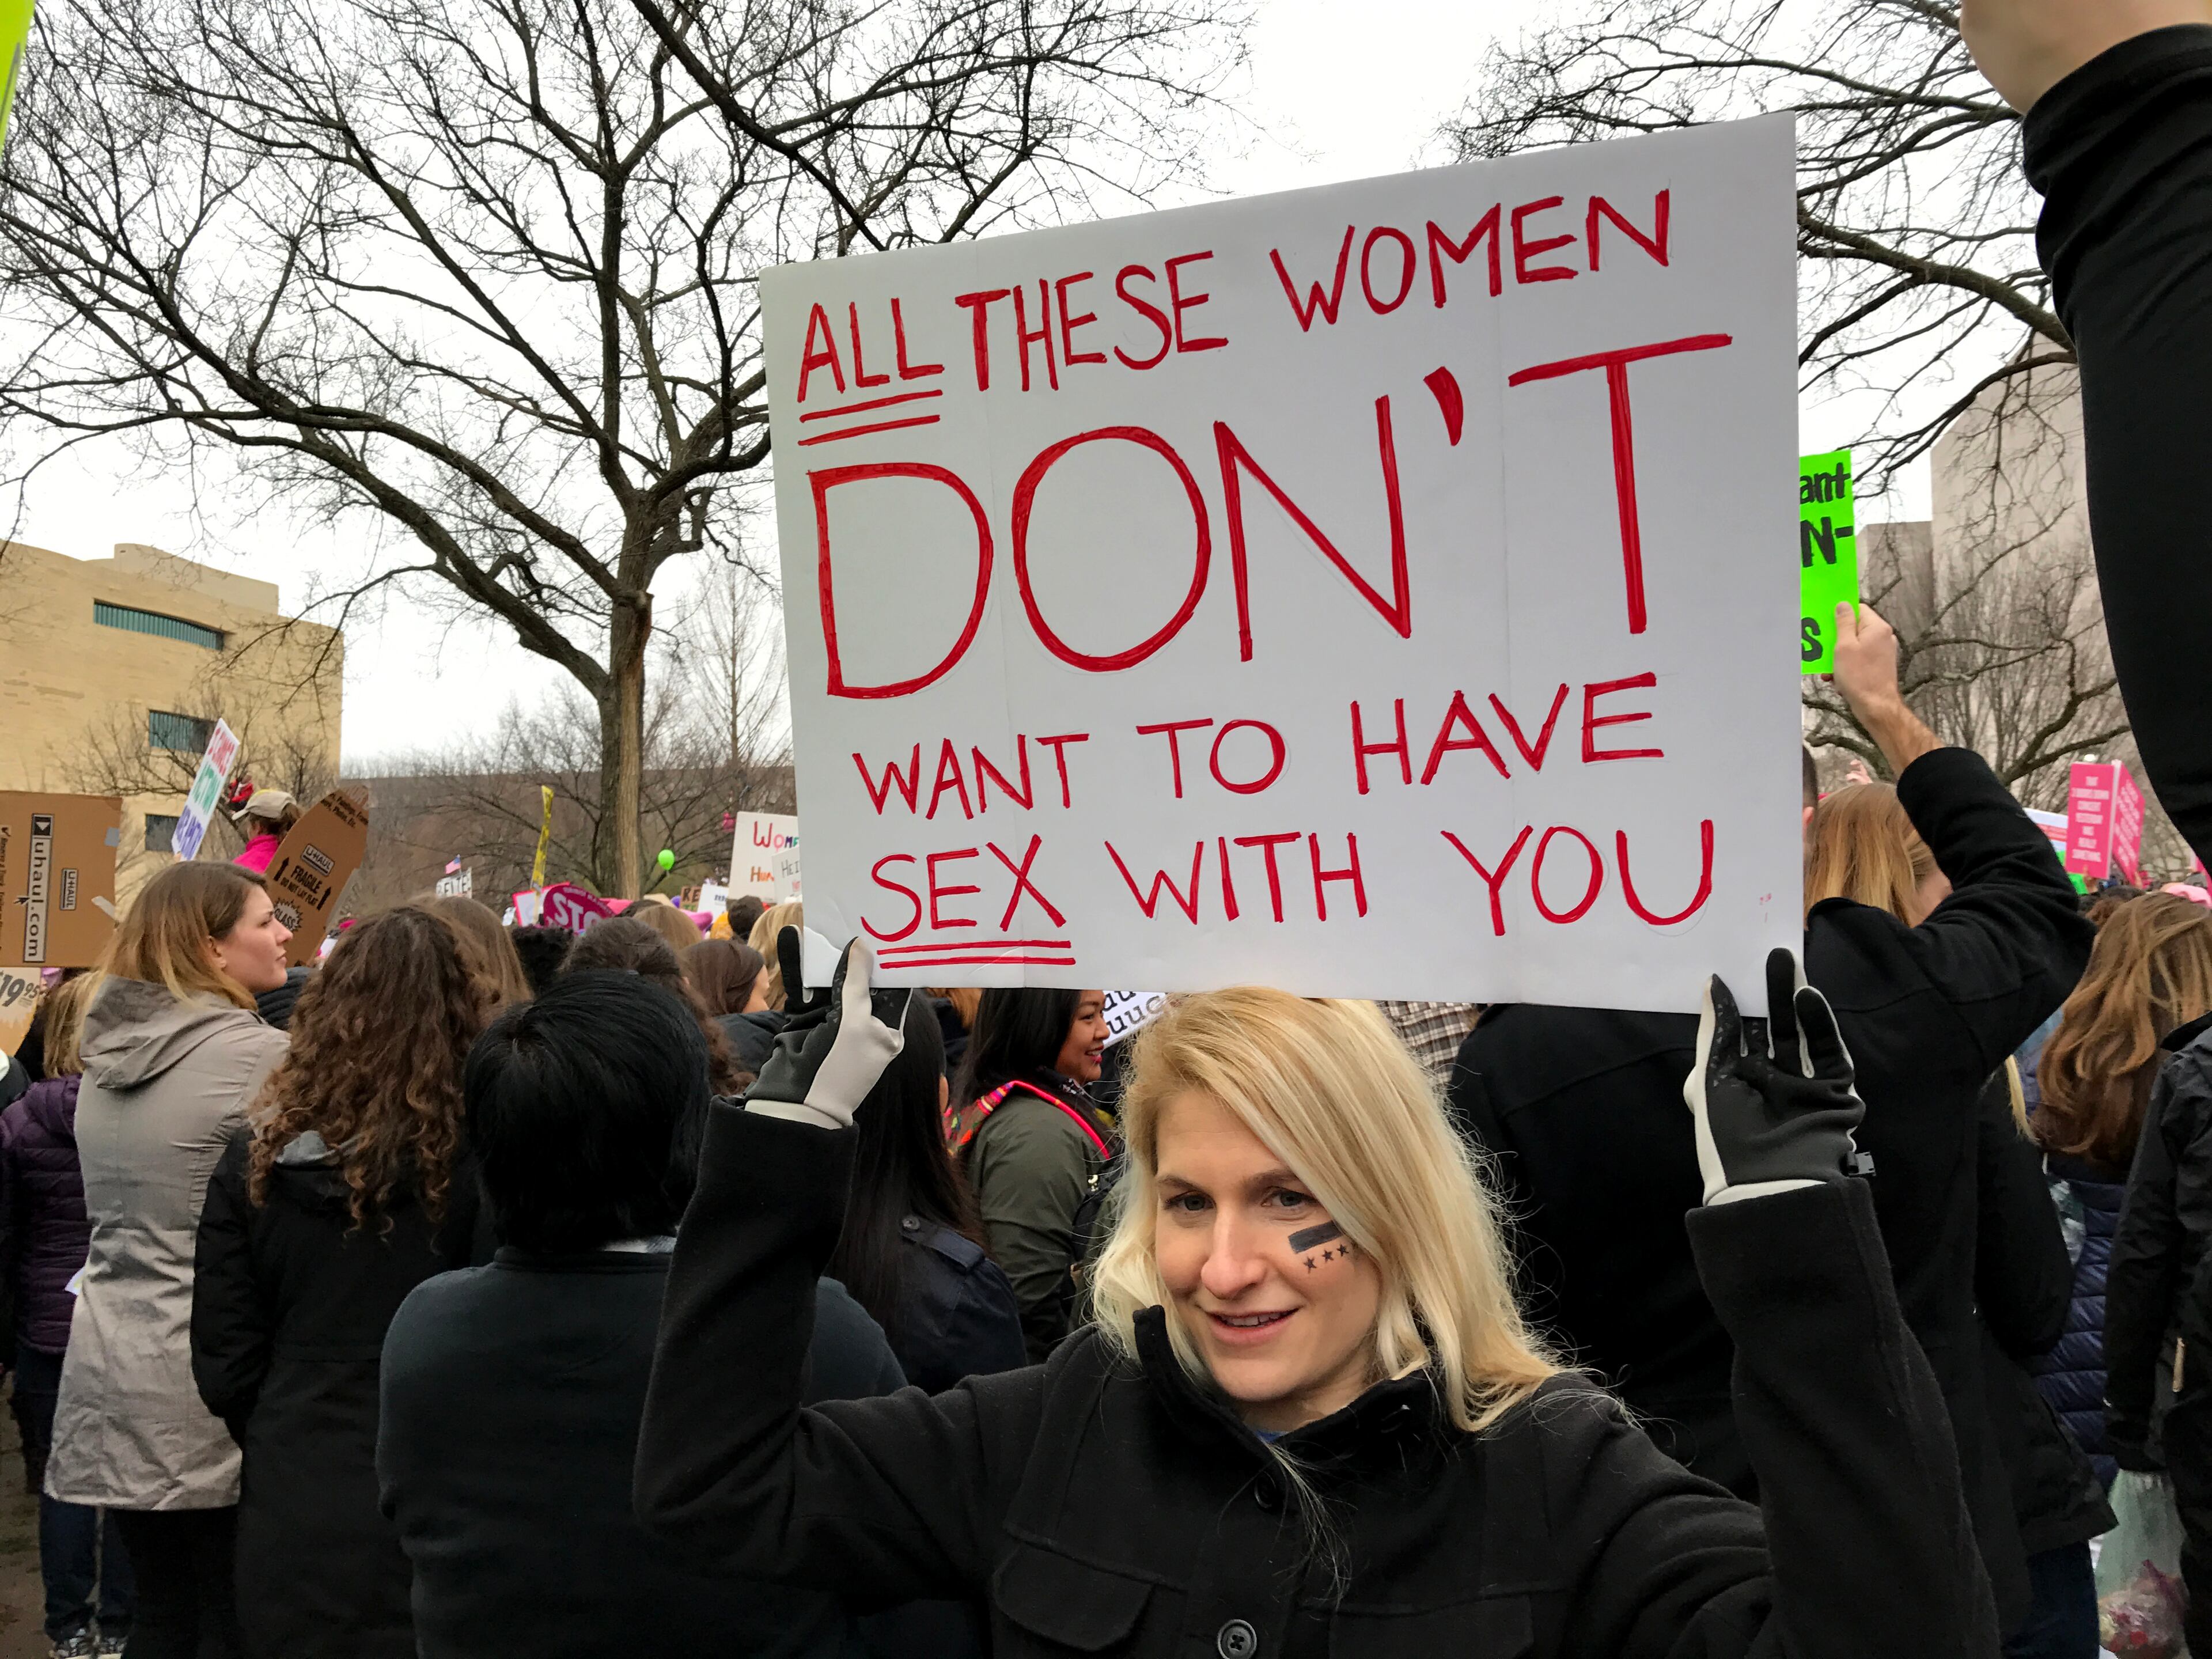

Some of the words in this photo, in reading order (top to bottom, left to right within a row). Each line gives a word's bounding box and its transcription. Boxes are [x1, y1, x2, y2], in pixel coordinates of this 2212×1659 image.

[797, 298, 945, 403] ALL
[955, 250, 1228, 391] THESE
[1270, 189, 1669, 332] WOMEN
[806, 334, 1732, 699] DON'T
[853, 734, 1089, 820] WANT
[1137, 718, 1285, 798] TO
[1351, 672, 1664, 794] HAVE
[28, 841, 47, 957] uhaul.com
[290, 865, 323, 894] FRAGILE
[861, 834, 1066, 942] SEX
[1105, 832, 1367, 925] WITH
[1441, 820, 1714, 936] YOU
